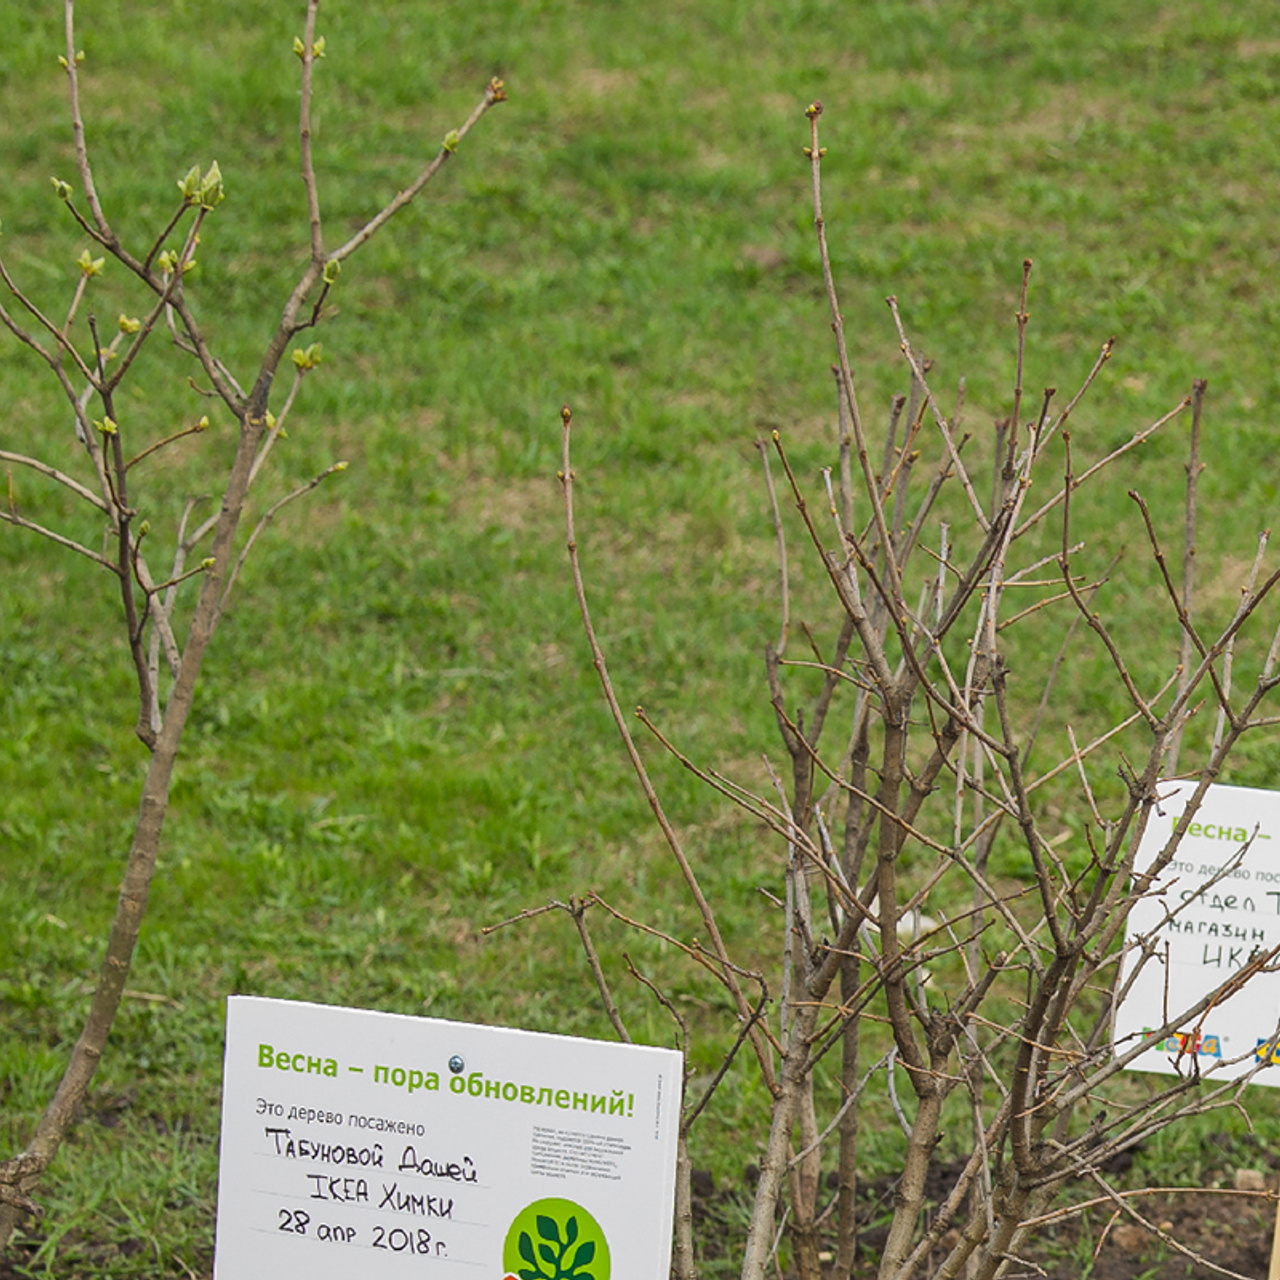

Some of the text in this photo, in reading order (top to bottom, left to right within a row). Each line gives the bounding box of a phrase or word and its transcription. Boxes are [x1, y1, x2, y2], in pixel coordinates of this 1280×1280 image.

[1198, 864, 1251, 882] деево
[258, 1044, 337, 1077] Весна
[374, 1065, 439, 1093] пора
[449, 1072, 637, 1119] обновлений!
[256, 1098, 425, 1136] Это дерево посажено
[396, 1146, 477, 1185] Дашей
[306, 1174, 368, 1202] IKEA
[278, 1209, 309, 1234] 28
